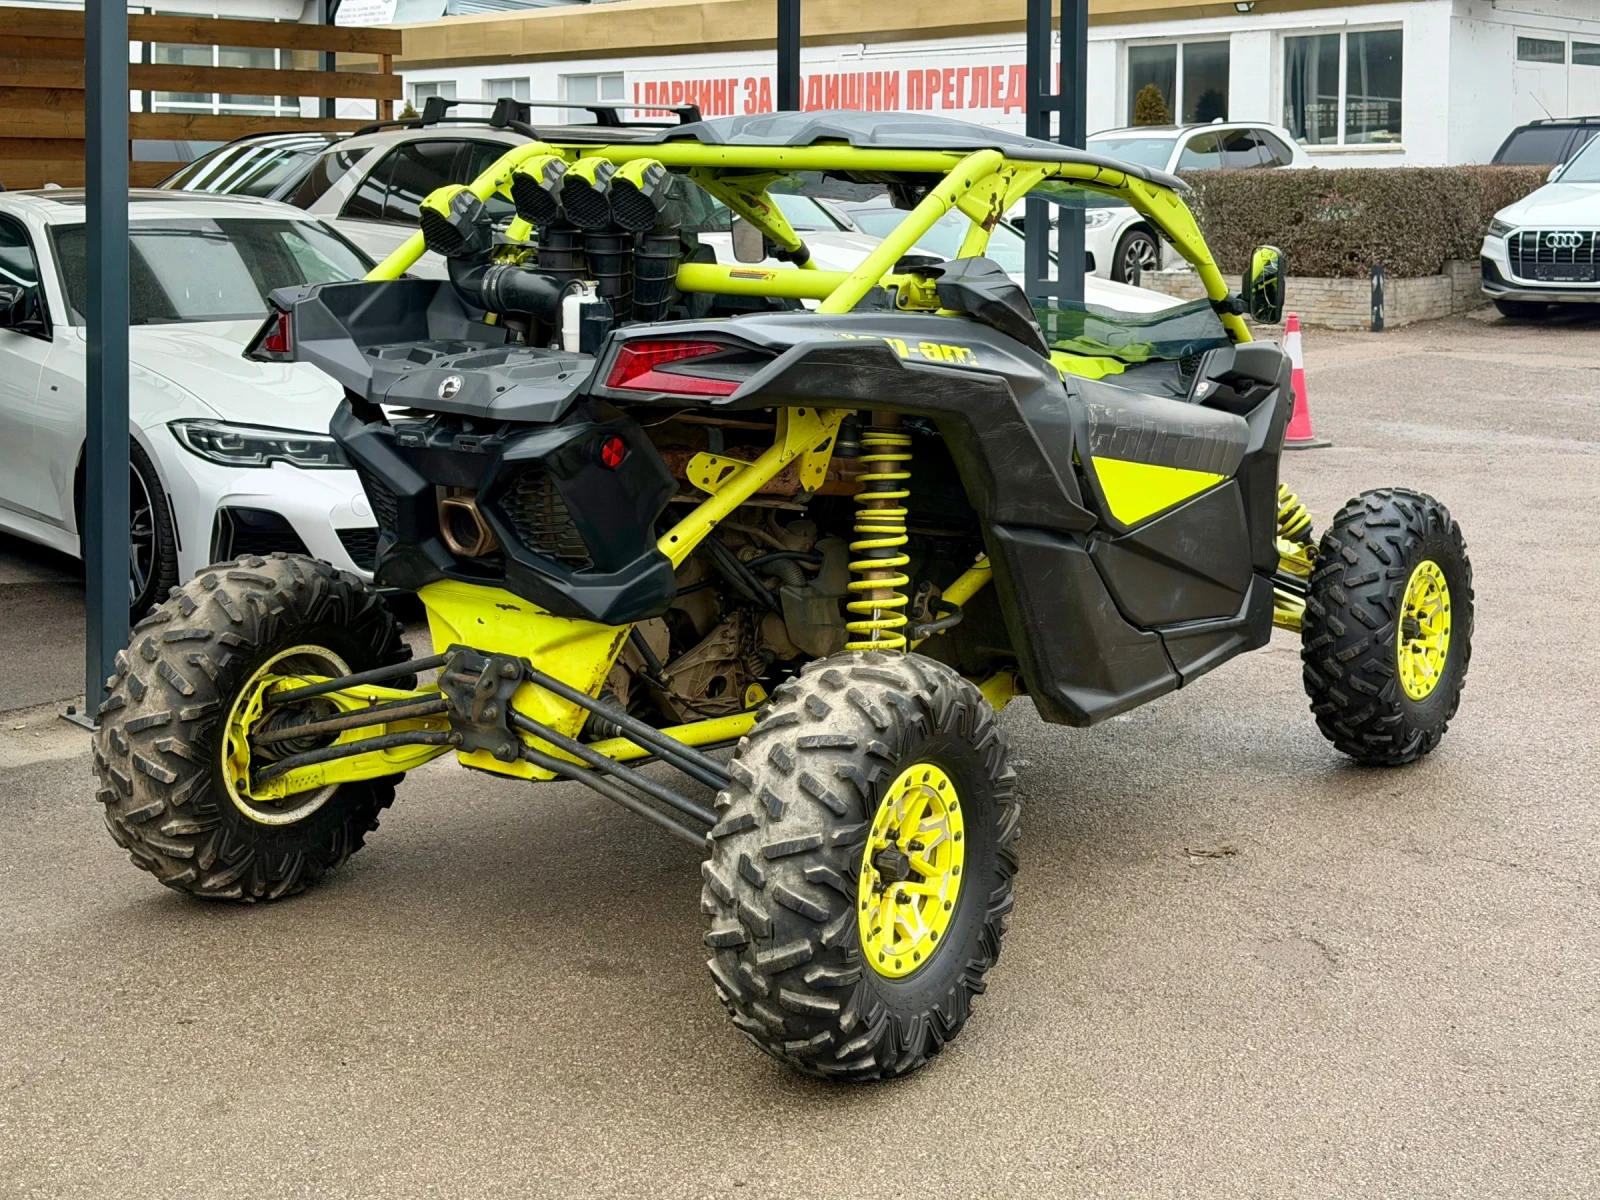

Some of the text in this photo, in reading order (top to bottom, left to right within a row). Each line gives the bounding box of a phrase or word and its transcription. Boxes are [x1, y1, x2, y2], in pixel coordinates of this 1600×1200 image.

[645, 78, 738, 118] ПАРКИНГ
[743, 77, 772, 116] ЗА
[799, 70, 900, 113] ДИШНИ
[906, 64, 1027, 115] ПРЕГЛЕД
